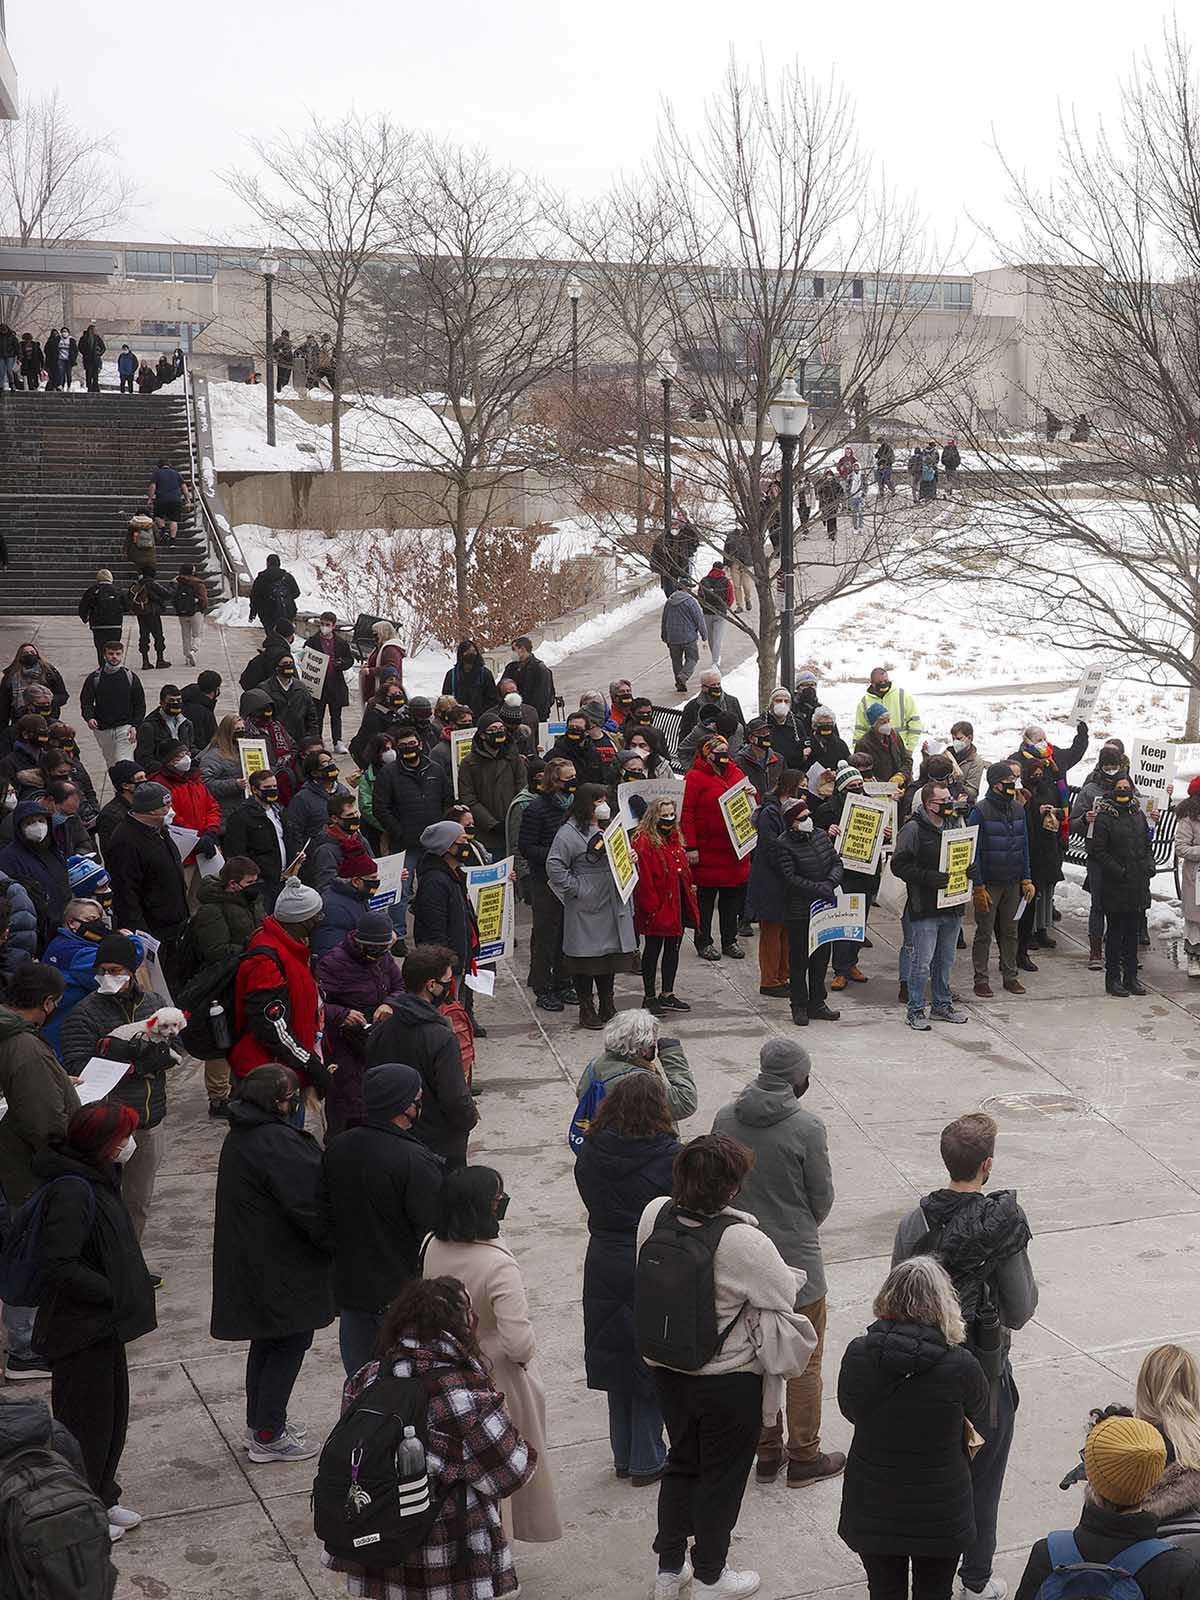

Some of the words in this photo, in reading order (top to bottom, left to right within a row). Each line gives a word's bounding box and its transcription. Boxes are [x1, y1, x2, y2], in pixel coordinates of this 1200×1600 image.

[1141, 744, 1167, 760] Keep
[1140, 760, 1164, 773] Your
[1134, 774, 1166, 790] Word!
[355, 1534, 378, 1546] adidas
